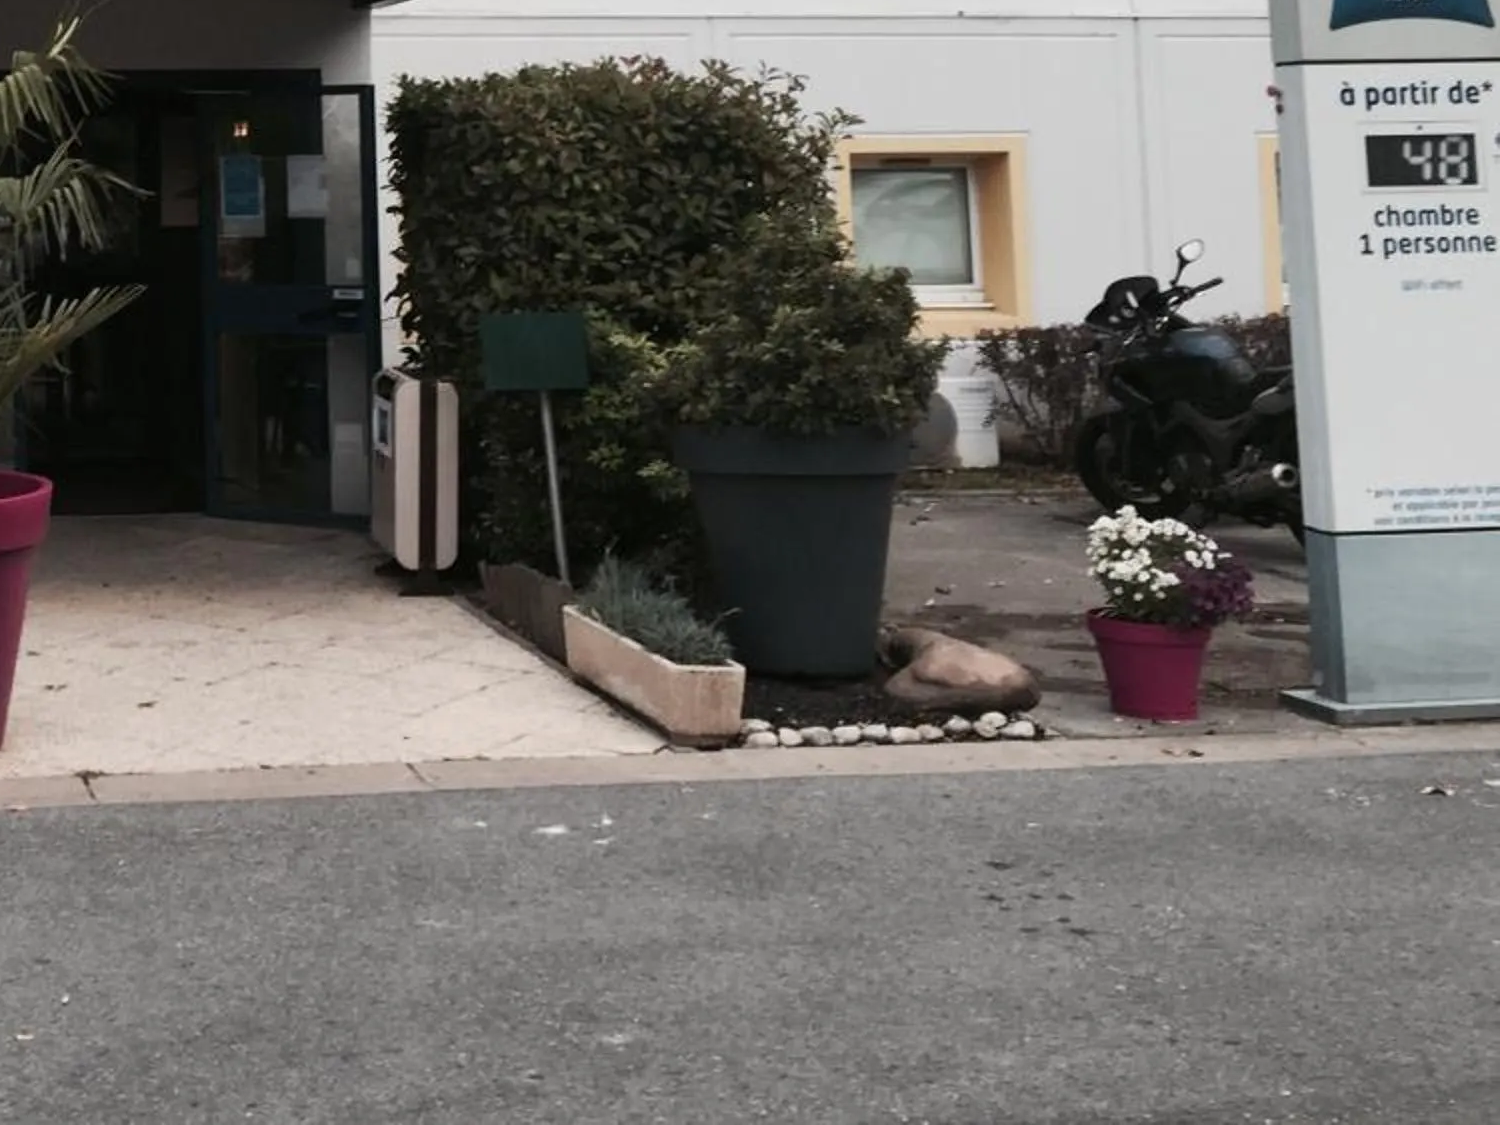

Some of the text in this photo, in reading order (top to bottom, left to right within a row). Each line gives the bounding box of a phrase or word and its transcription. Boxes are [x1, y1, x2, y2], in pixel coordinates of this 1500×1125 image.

[1339, 81, 1356, 106] à
[1364, 80, 1440, 111] partir
[1402, 136, 1468, 185] 48
[1373, 204, 1480, 227] chambre
[1360, 234, 1497, 259] 1 personne
